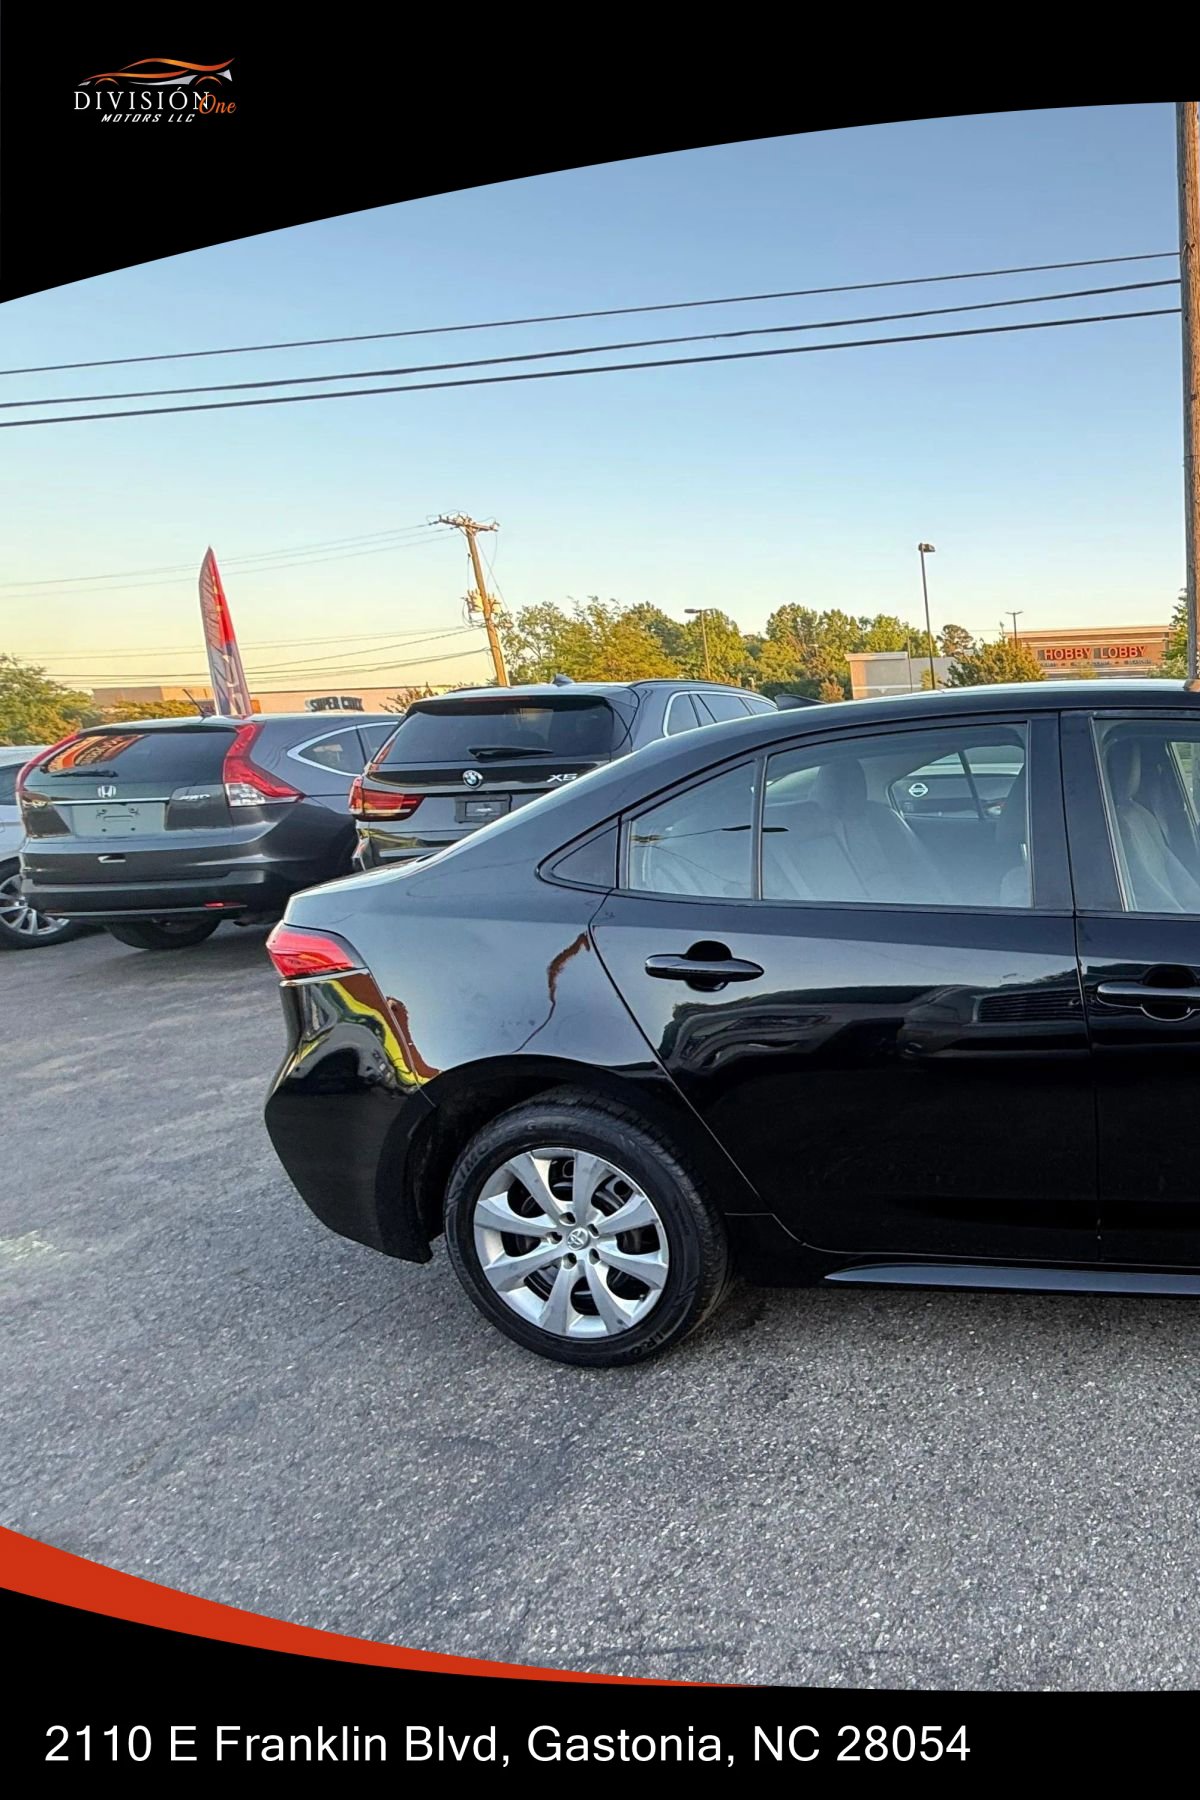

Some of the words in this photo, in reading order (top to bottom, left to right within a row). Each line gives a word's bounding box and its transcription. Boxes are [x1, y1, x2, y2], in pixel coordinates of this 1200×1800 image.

[1044, 647, 1092, 661] HOBBY
[1100, 645, 1146, 659] LOBBY
[547, 773, 578, 783] X5
